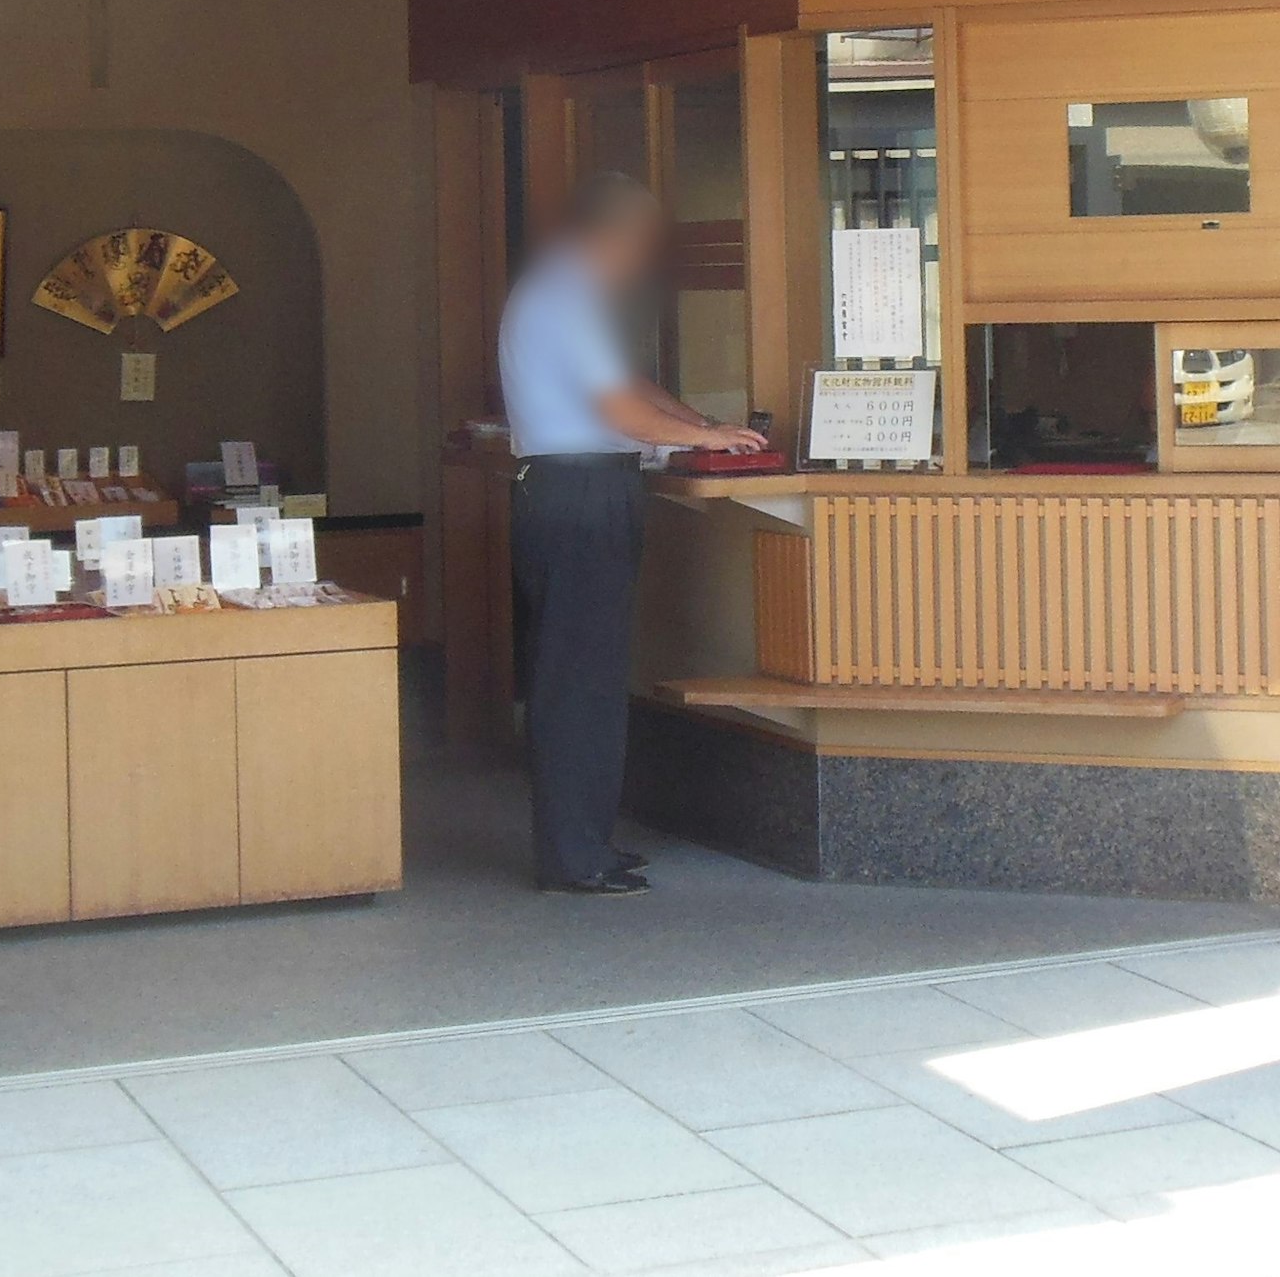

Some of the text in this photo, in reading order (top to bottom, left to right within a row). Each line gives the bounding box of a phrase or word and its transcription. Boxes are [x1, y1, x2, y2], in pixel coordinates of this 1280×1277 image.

[866, 400, 914, 412] 600円
[865, 415, 913, 427] 500円
[864, 430, 912, 443] 400円
